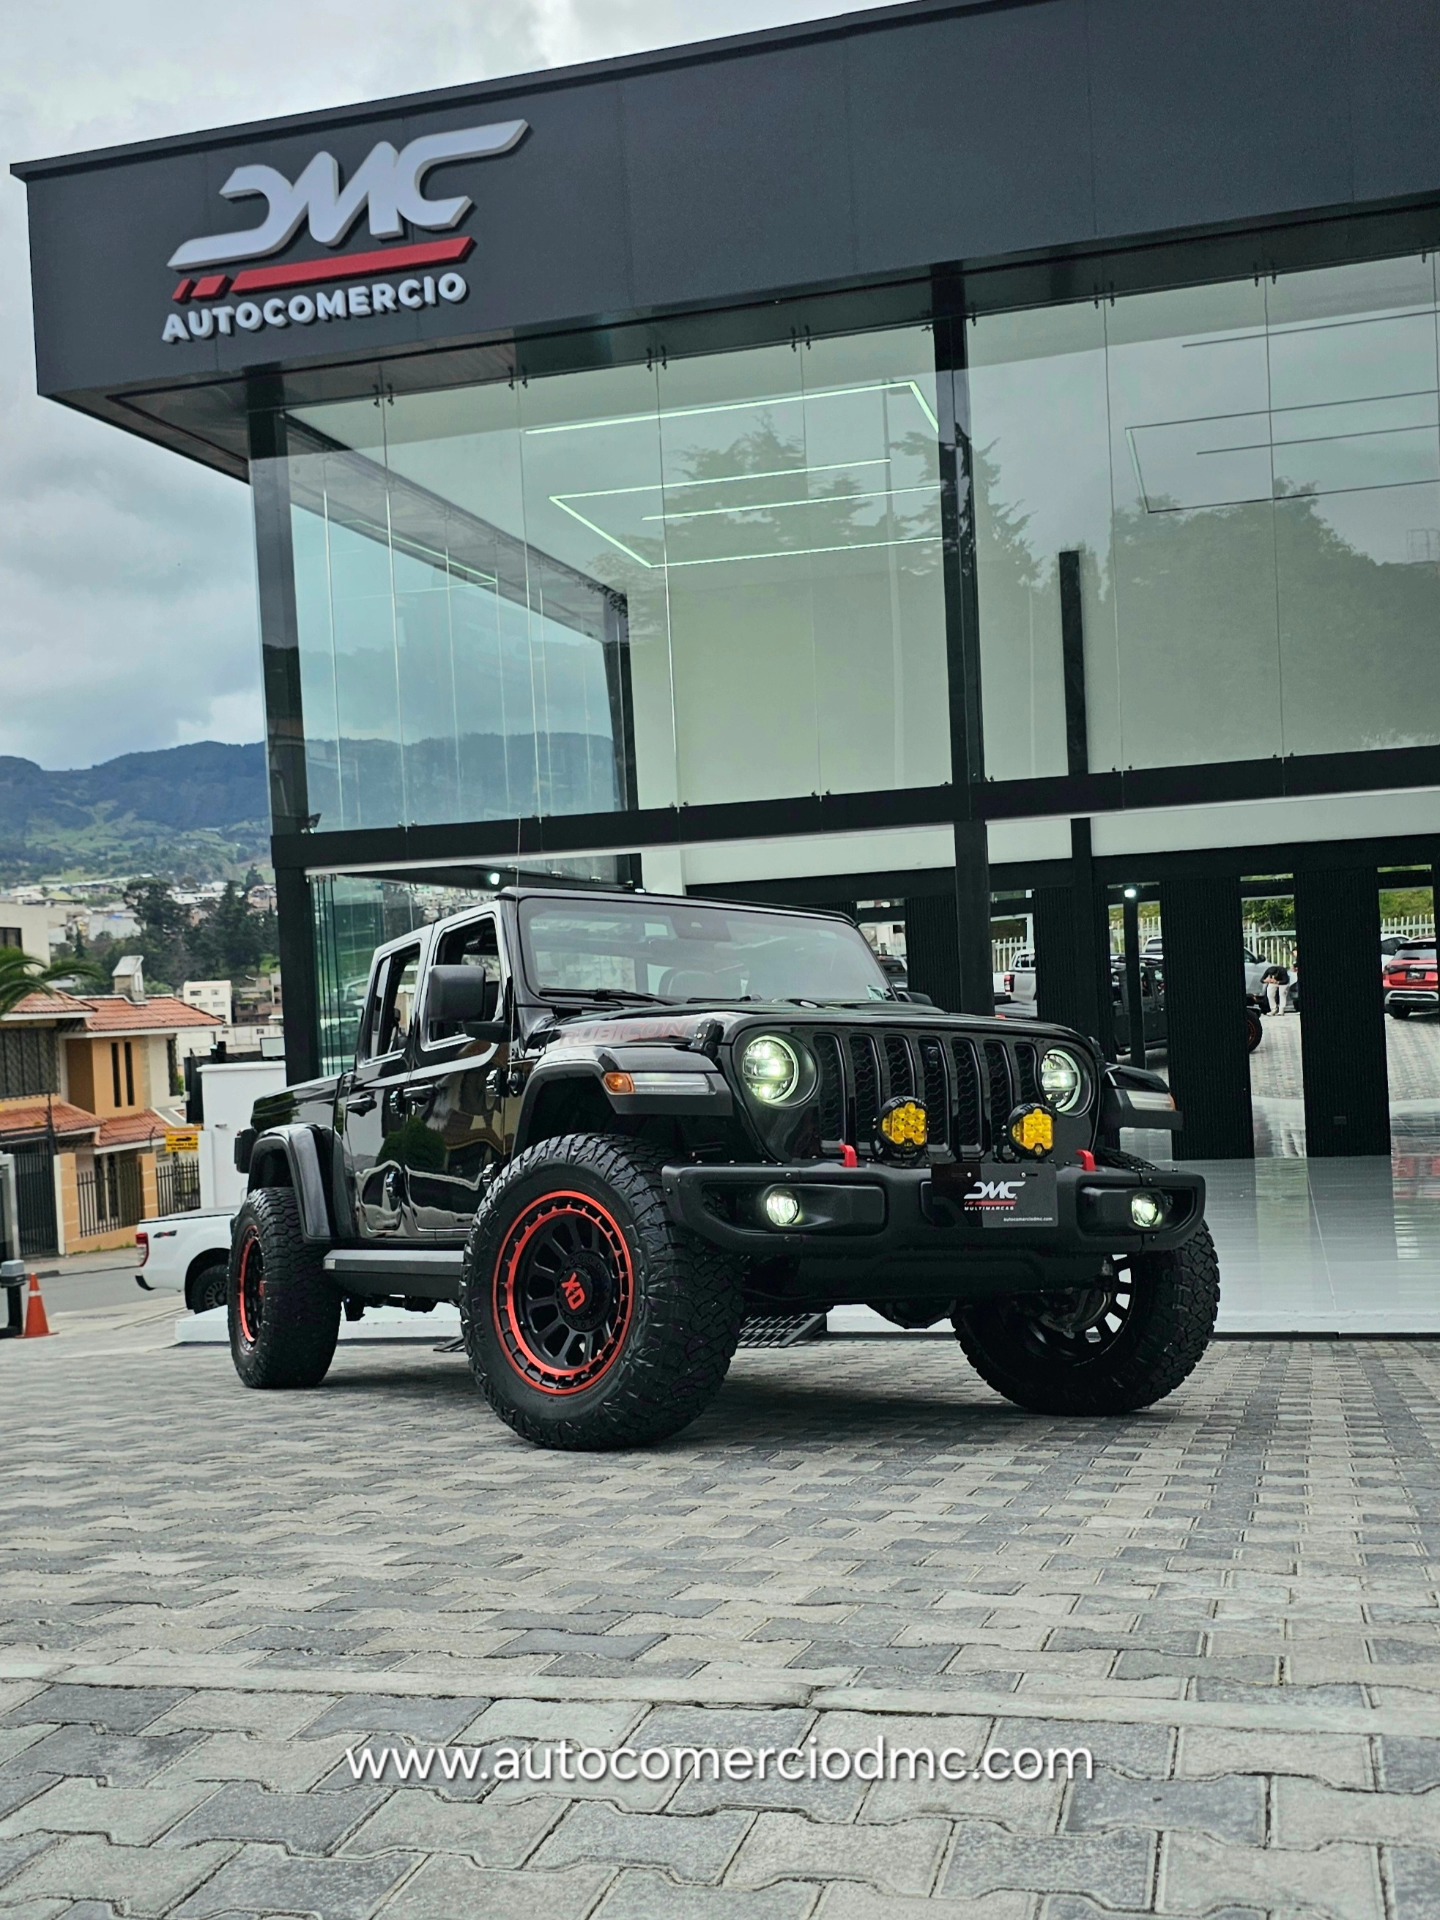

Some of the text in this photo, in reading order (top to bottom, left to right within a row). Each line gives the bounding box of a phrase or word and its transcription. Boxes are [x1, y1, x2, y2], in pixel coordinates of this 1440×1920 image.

[167, 119, 529, 271] DMC
[162, 272, 467, 344] AUTOCOMERCIO
[560, 1021, 689, 1046] RUBICON
[964, 1181, 1026, 1200] DMC
[561, 1272, 586, 1310] XD
